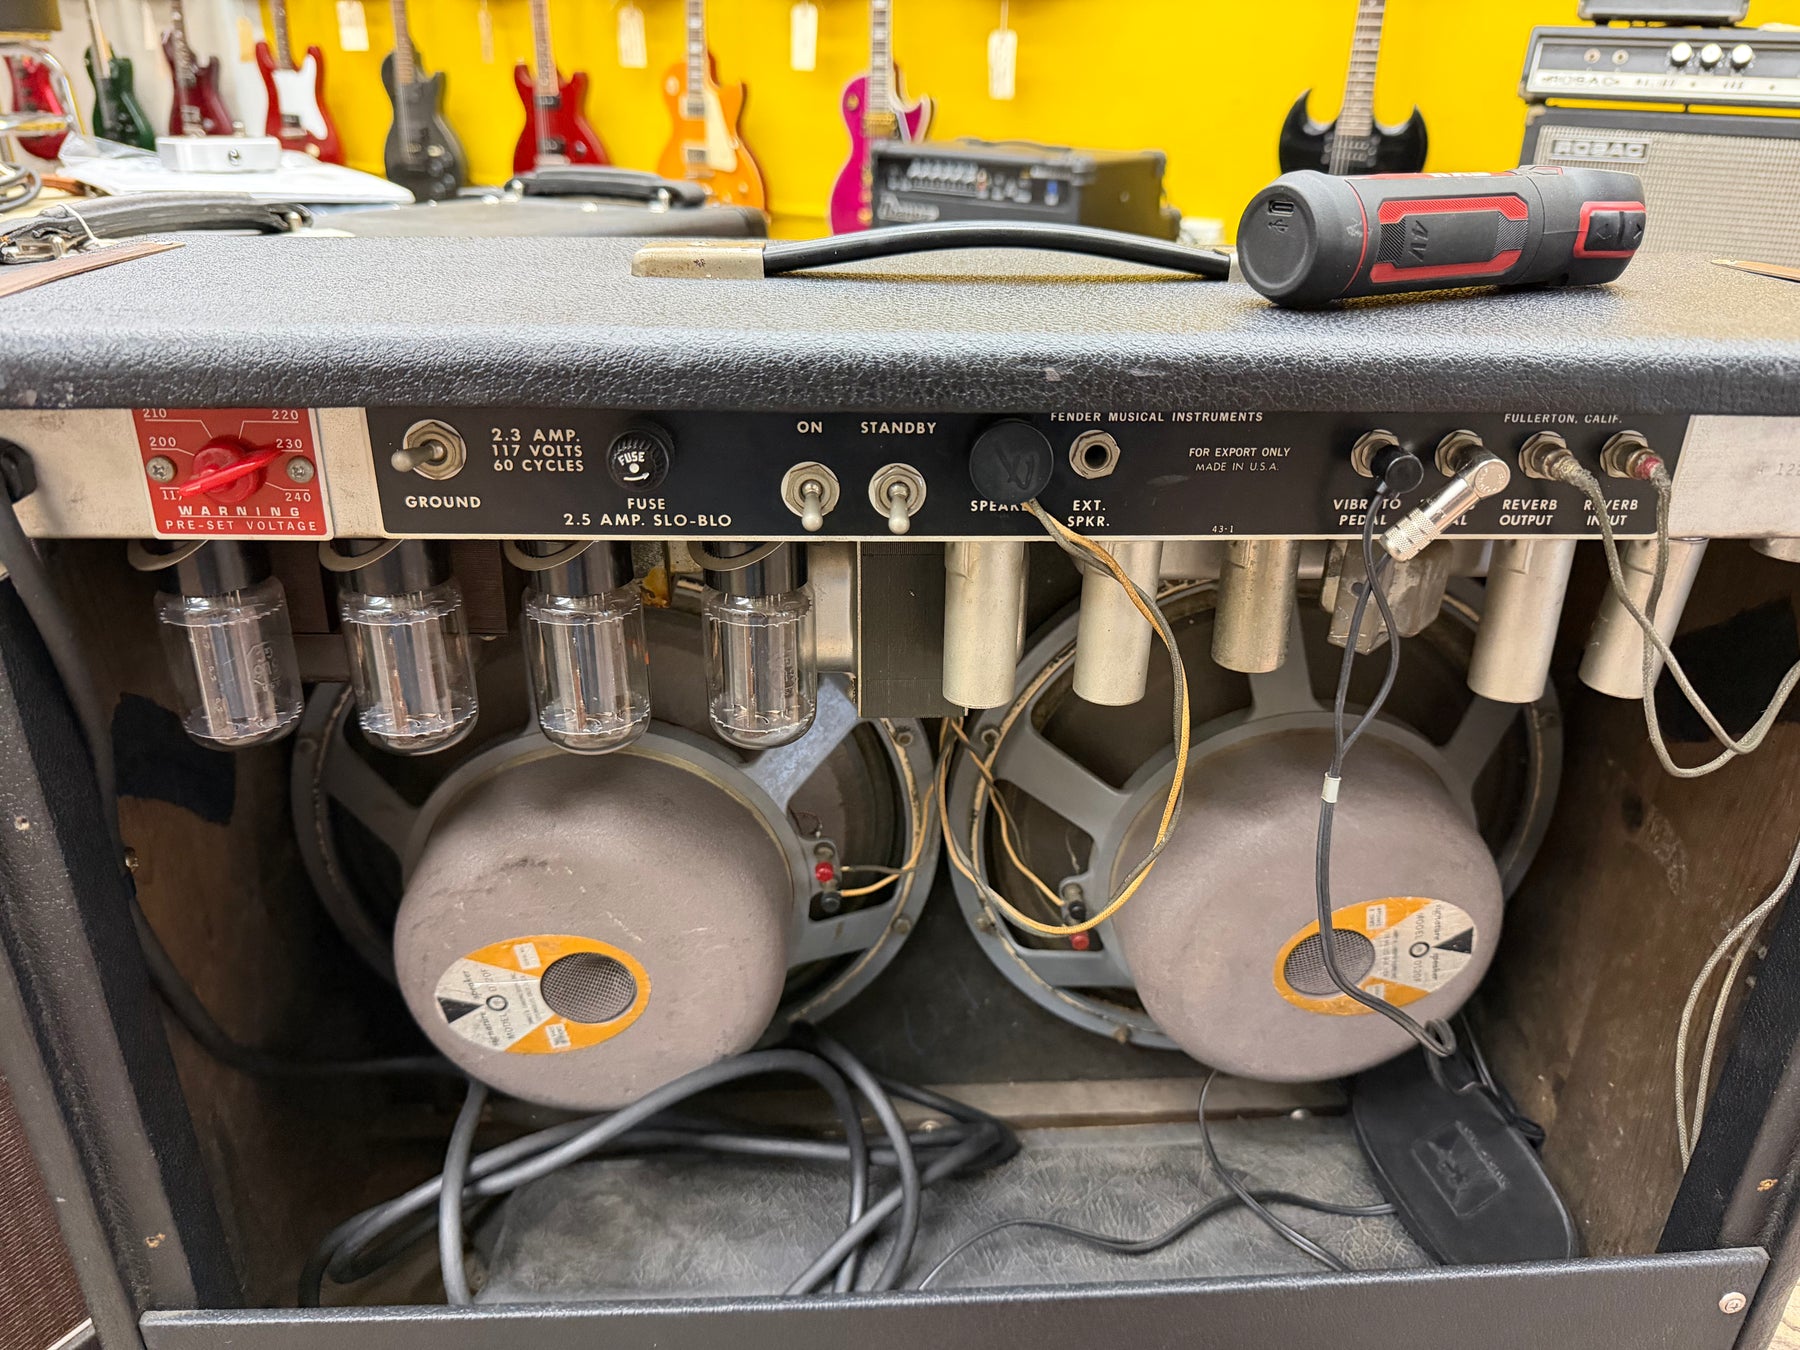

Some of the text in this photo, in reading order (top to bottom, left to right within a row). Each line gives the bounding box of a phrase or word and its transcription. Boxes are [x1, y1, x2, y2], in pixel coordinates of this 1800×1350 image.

[143, 408, 167, 418] 210
[272, 409, 299, 420] 220
[1050, 411, 1263, 422] FENDER MUSICAL INSTRUMENTS
[1503, 413, 1578, 424] FULLERTON,
[797, 421, 823, 434] ON
[861, 422, 937, 434] STANDBY
[491, 428, 580, 442] 2.3 AMP.
[149, 436, 176, 447] 200
[276, 438, 303, 449] 230
[492, 444, 583, 457] 117 VOLTS
[1189, 447, 1291, 457] FOR EXPORT ONLY
[617, 450, 646, 466] FUSE
[494, 459, 585, 472] 60 CYCLES
[1195, 462, 1279, 472] MADE IN U.S.A.
[285, 492, 311, 502] 240
[405, 495, 482, 508] GROUND
[627, 498, 666, 510] FUSE
[1073, 499, 1106, 512] EXT.
[1333, 499, 1401, 510] VIBRTO
[1502, 499, 1558, 511] REVERB
[1583, 499, 1638, 511] RVERB
[178, 505, 300, 516] WARNING
[165, 519, 317, 531] PRE-SET VOLTAGE
[563, 513, 732, 527] 2.5 AMP. SLO-BLO
[1067, 515, 1110, 527] SPKR.
[1499, 514, 1553, 526] OUTPUT
[1586, 515, 1628, 526] INUT
[1212, 525, 1235, 533] 43-1
